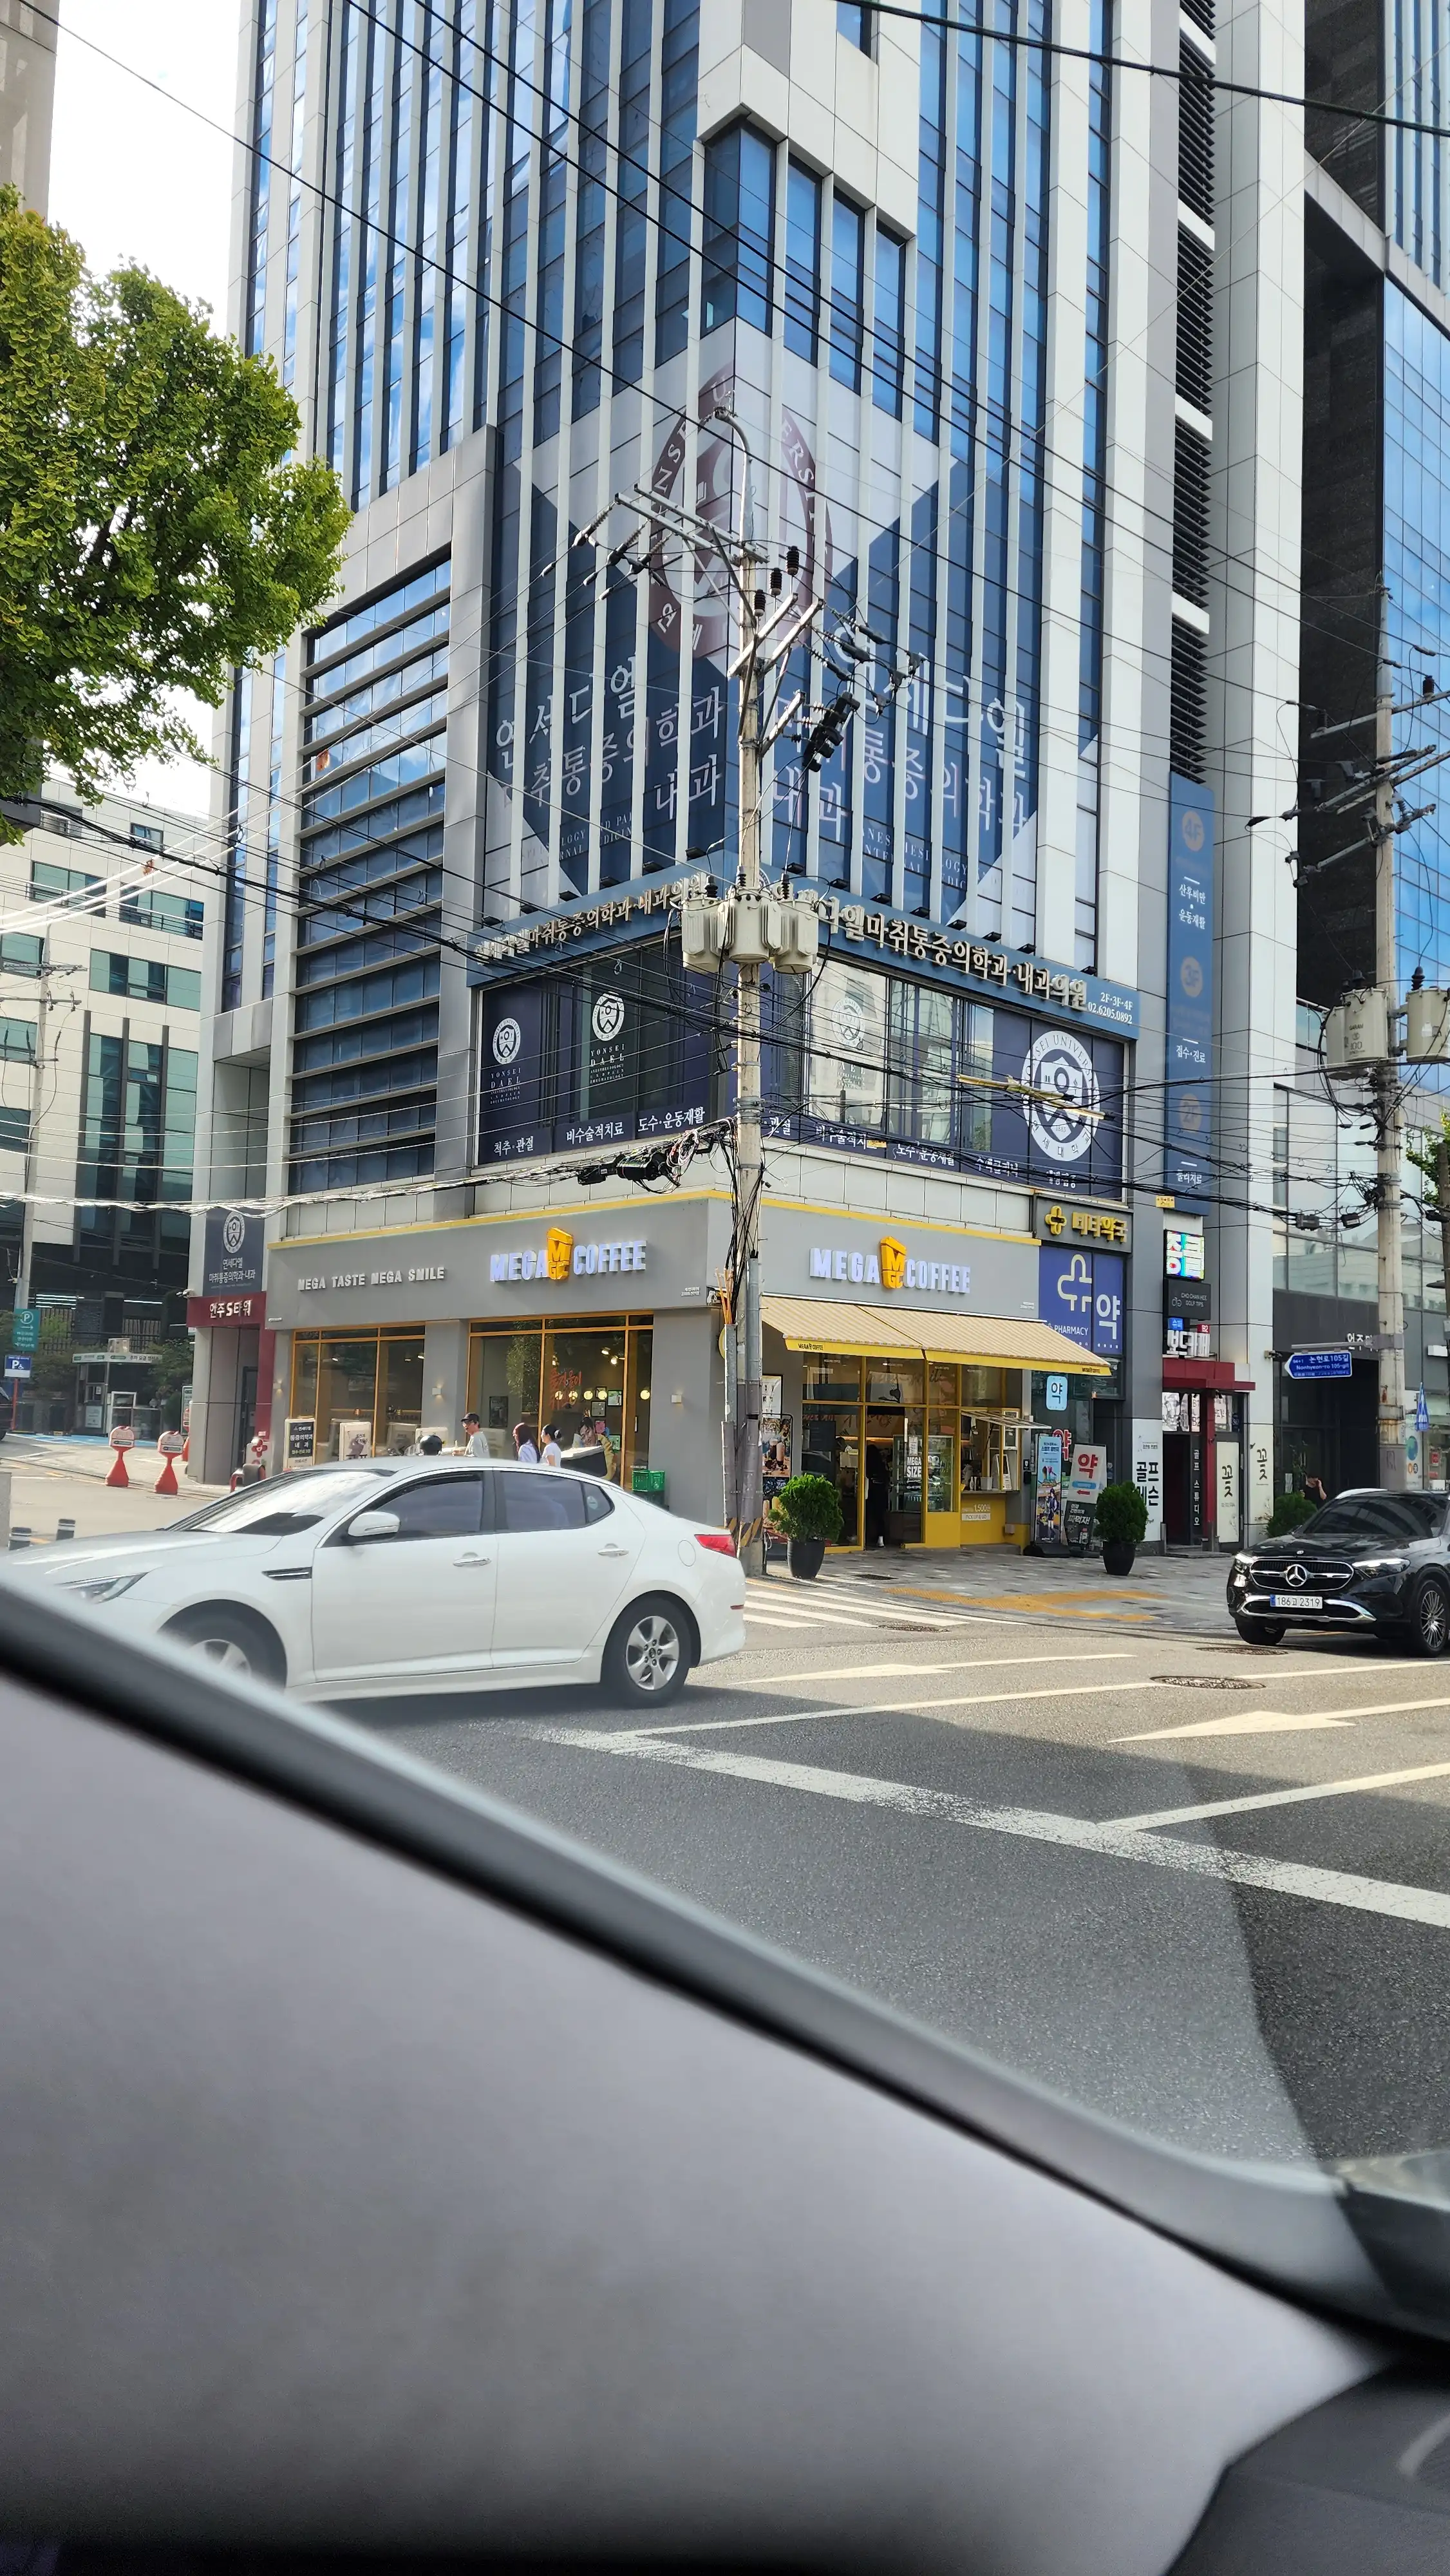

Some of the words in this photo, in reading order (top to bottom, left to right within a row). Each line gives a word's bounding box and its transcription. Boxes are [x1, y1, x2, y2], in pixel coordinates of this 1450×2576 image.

[1178, 883, 1207, 905] 산후비만
[1178, 908, 1207, 930] 운동재활
[1088, 1002, 1133, 1025] 02.6205.0892
[590, 1043, 625, 1057] YONSEI
[590, 1053, 625, 1066] DAEL
[1176, 1045, 1206, 1063] 접수·진료
[491, 1067, 522, 1079] YONSEI
[491, 1075, 521, 1089] DAEL
[637, 1106, 706, 1132] 도수·운동재활
[566, 1121, 625, 1145] 비수술적치료
[493, 1135, 534, 1157] 척추·관절
[222, 1256, 243, 1271] 연세다엘
[489, 1249, 548, 1282] MEGA
[573, 1240, 646, 1275] COFFEE
[809, 1247, 880, 1284] MEGA
[905, 1259, 970, 1294] COFFEE
[297, 1276, 325, 1291] MEGA
[332, 1273, 365, 1288] TASTE
[371, 1270, 402, 1285] MEGA
[408, 1267, 444, 1282] SMILE
[1096, 1294, 1120, 1340] 약
[1201, 1324, 1209, 1332] B2
[1054, 1325, 1088, 1336] PHARMACY
[12, 1359, 19, 1369] P
[1051, 1382, 1063, 1405] 약
[907, 1456, 921, 1466] MEGA
[907, 1466, 922, 1477] SIZE
[1077, 1454, 1099, 1479] 약
[1136, 1461, 1160, 1482] 골프
[1257, 1448, 1268, 1481] 꽃
[1221, 1464, 1234, 1498] 꽃
[1277, 1596, 1297, 1607] 186고
[1299, 1596, 1321, 1608] 2319
